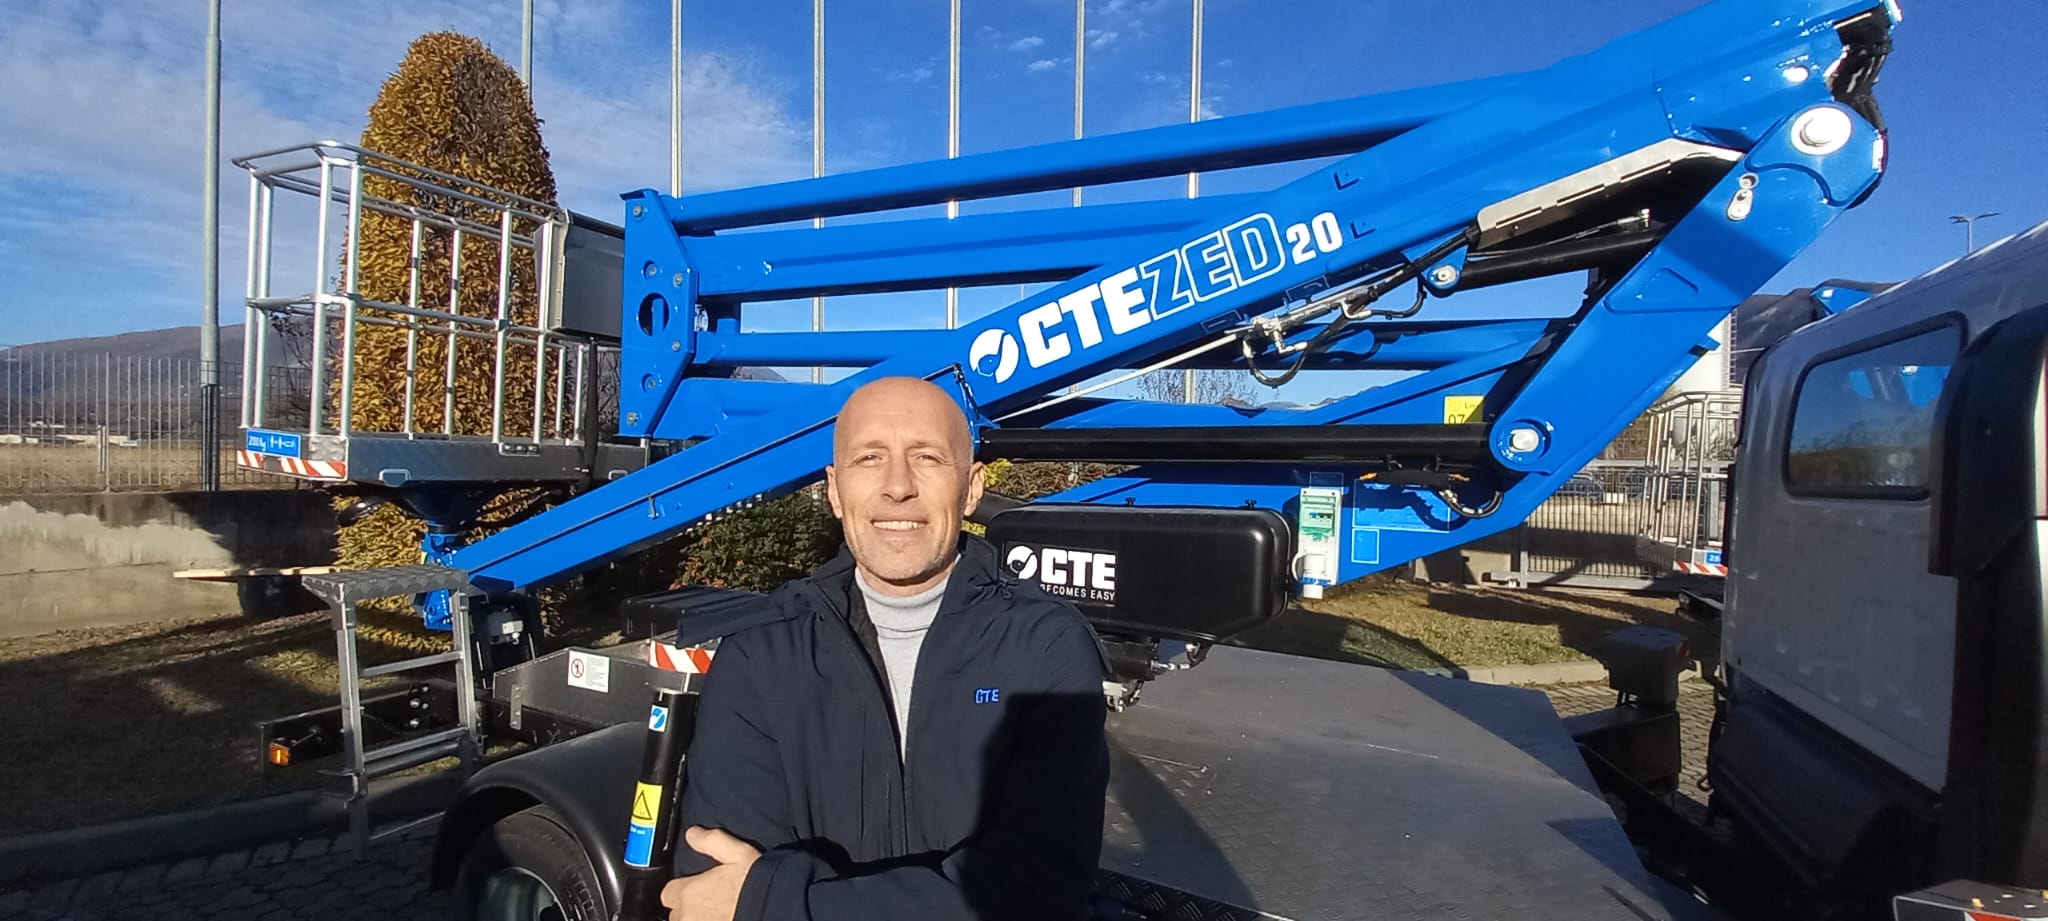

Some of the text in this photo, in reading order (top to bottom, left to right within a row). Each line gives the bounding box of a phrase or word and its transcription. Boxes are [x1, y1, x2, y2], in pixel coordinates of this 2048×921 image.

[1286, 212, 1344, 265] 20
[1041, 548, 1117, 590] CTE
[1090, 589, 1116, 601] EASY
[975, 688, 1000, 704] CTE
